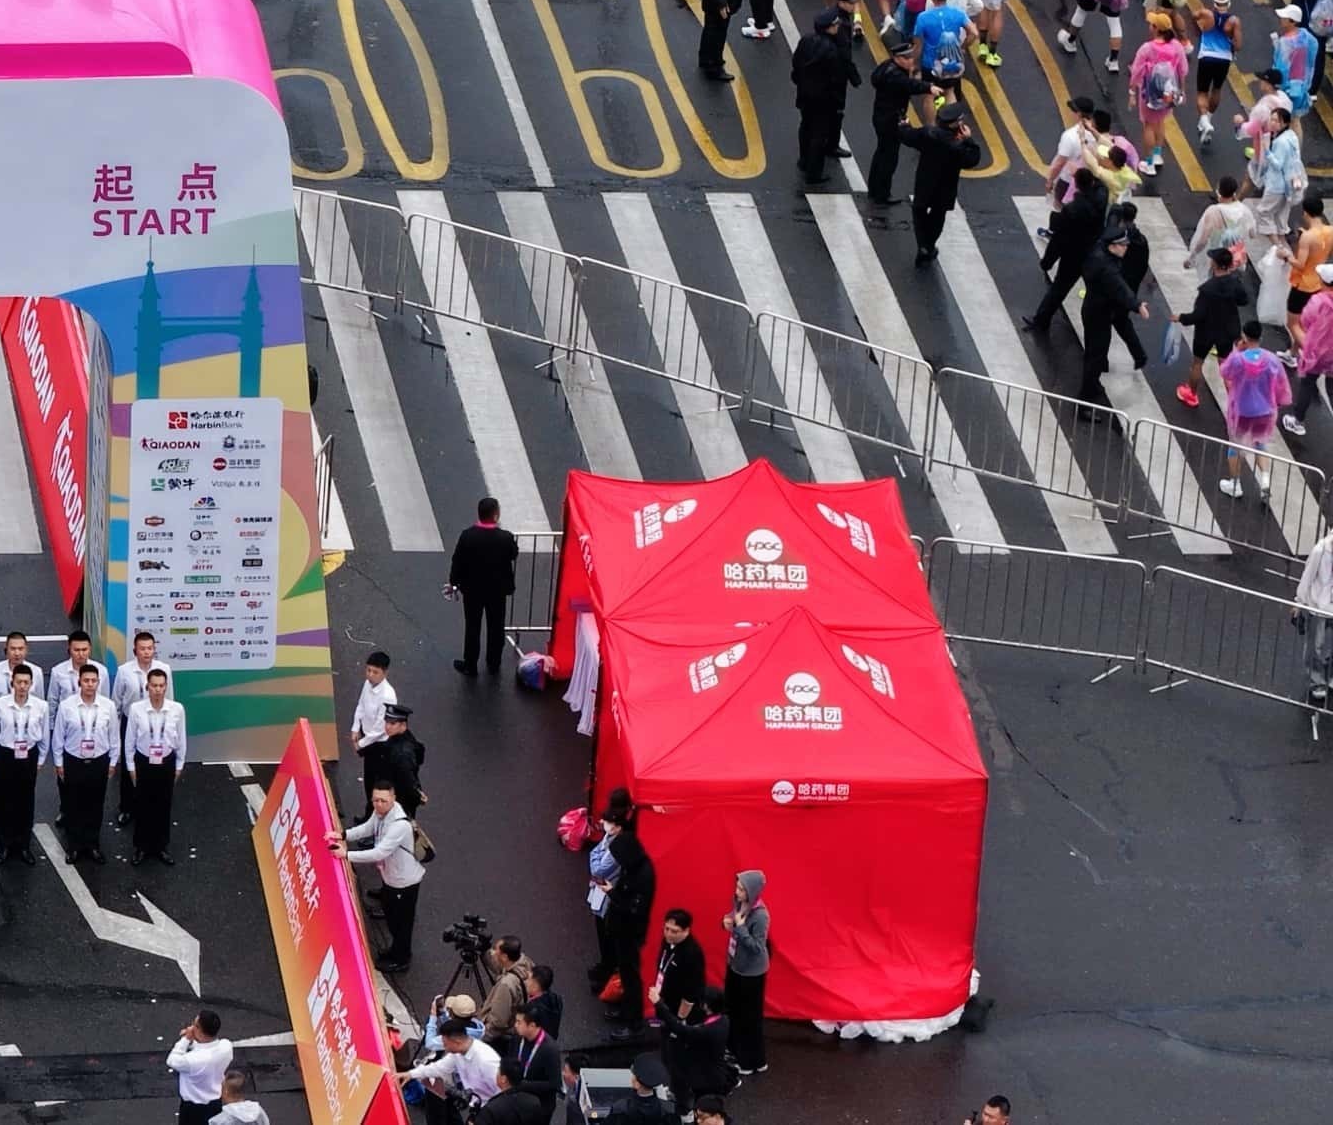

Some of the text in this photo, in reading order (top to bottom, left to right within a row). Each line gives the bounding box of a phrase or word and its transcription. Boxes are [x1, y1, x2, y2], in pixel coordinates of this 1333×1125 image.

[93, 163, 217, 203] 起点
[92, 208, 216, 238] START
[190, 421, 243, 429] HarbinBank
[149, 441, 201, 450] QIAODAN
[167, 478, 196, 491] 蒙牛
[724, 563, 807, 582] 哈药集团
[725, 581, 808, 590] HAPHARM GROUP
[764, 705, 842, 722] 哈药集团
[811, 722, 843, 730] GROUP
[797, 783, 850, 795] 哈药集团
